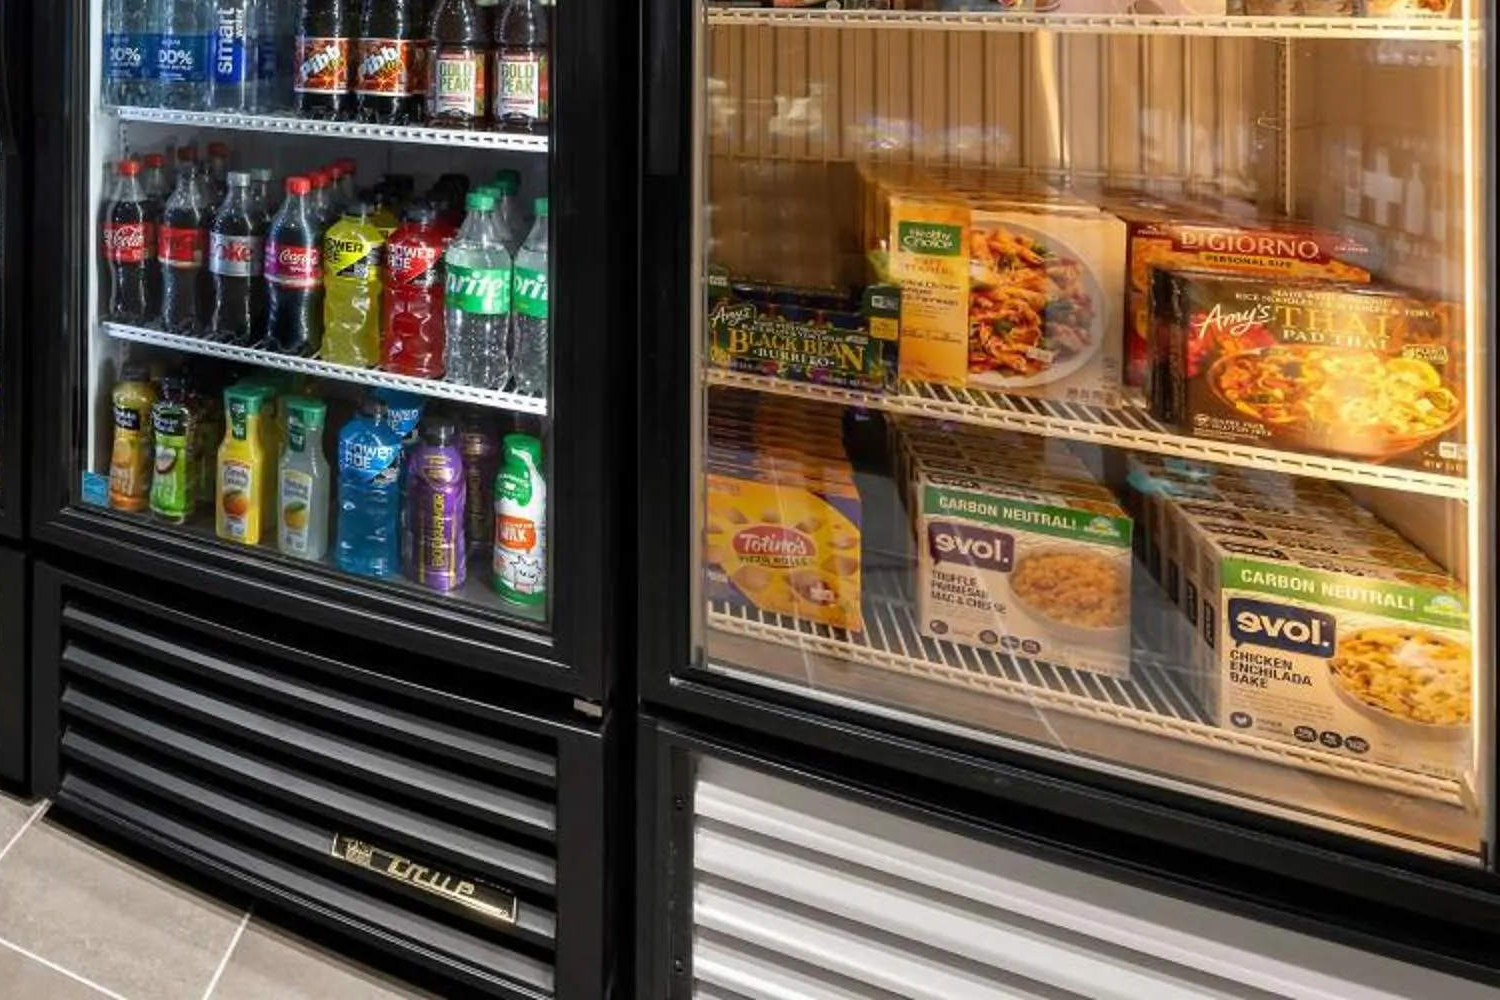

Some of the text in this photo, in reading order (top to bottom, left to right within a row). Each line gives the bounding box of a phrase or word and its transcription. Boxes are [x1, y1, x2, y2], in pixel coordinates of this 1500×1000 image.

[217, 7, 235, 75] smart
[501, 63, 534, 79] GOLD
[1205, 255, 1265, 266] PERSONAL
[1196, 303, 1272, 338] Amy's
[1275, 305, 1392, 337] THAI
[729, 328, 798, 354] BLACK
[804, 335, 865, 371] BEAN
[1283, 329, 1390, 350] PAD THAI
[938, 495, 1078, 531] CARBON NEUTRAL!
[738, 533, 807, 555] Totino's
[935, 532, 1009, 564] evol.
[1241, 568, 1415, 612] CARBON NEUTRAL!
[1236, 611, 1331, 647] evol.
[1229, 649, 1293, 671] CHICKEN
[1229, 660, 1314, 687] ENCHILADA
[1229, 671, 1268, 689] BAKE
